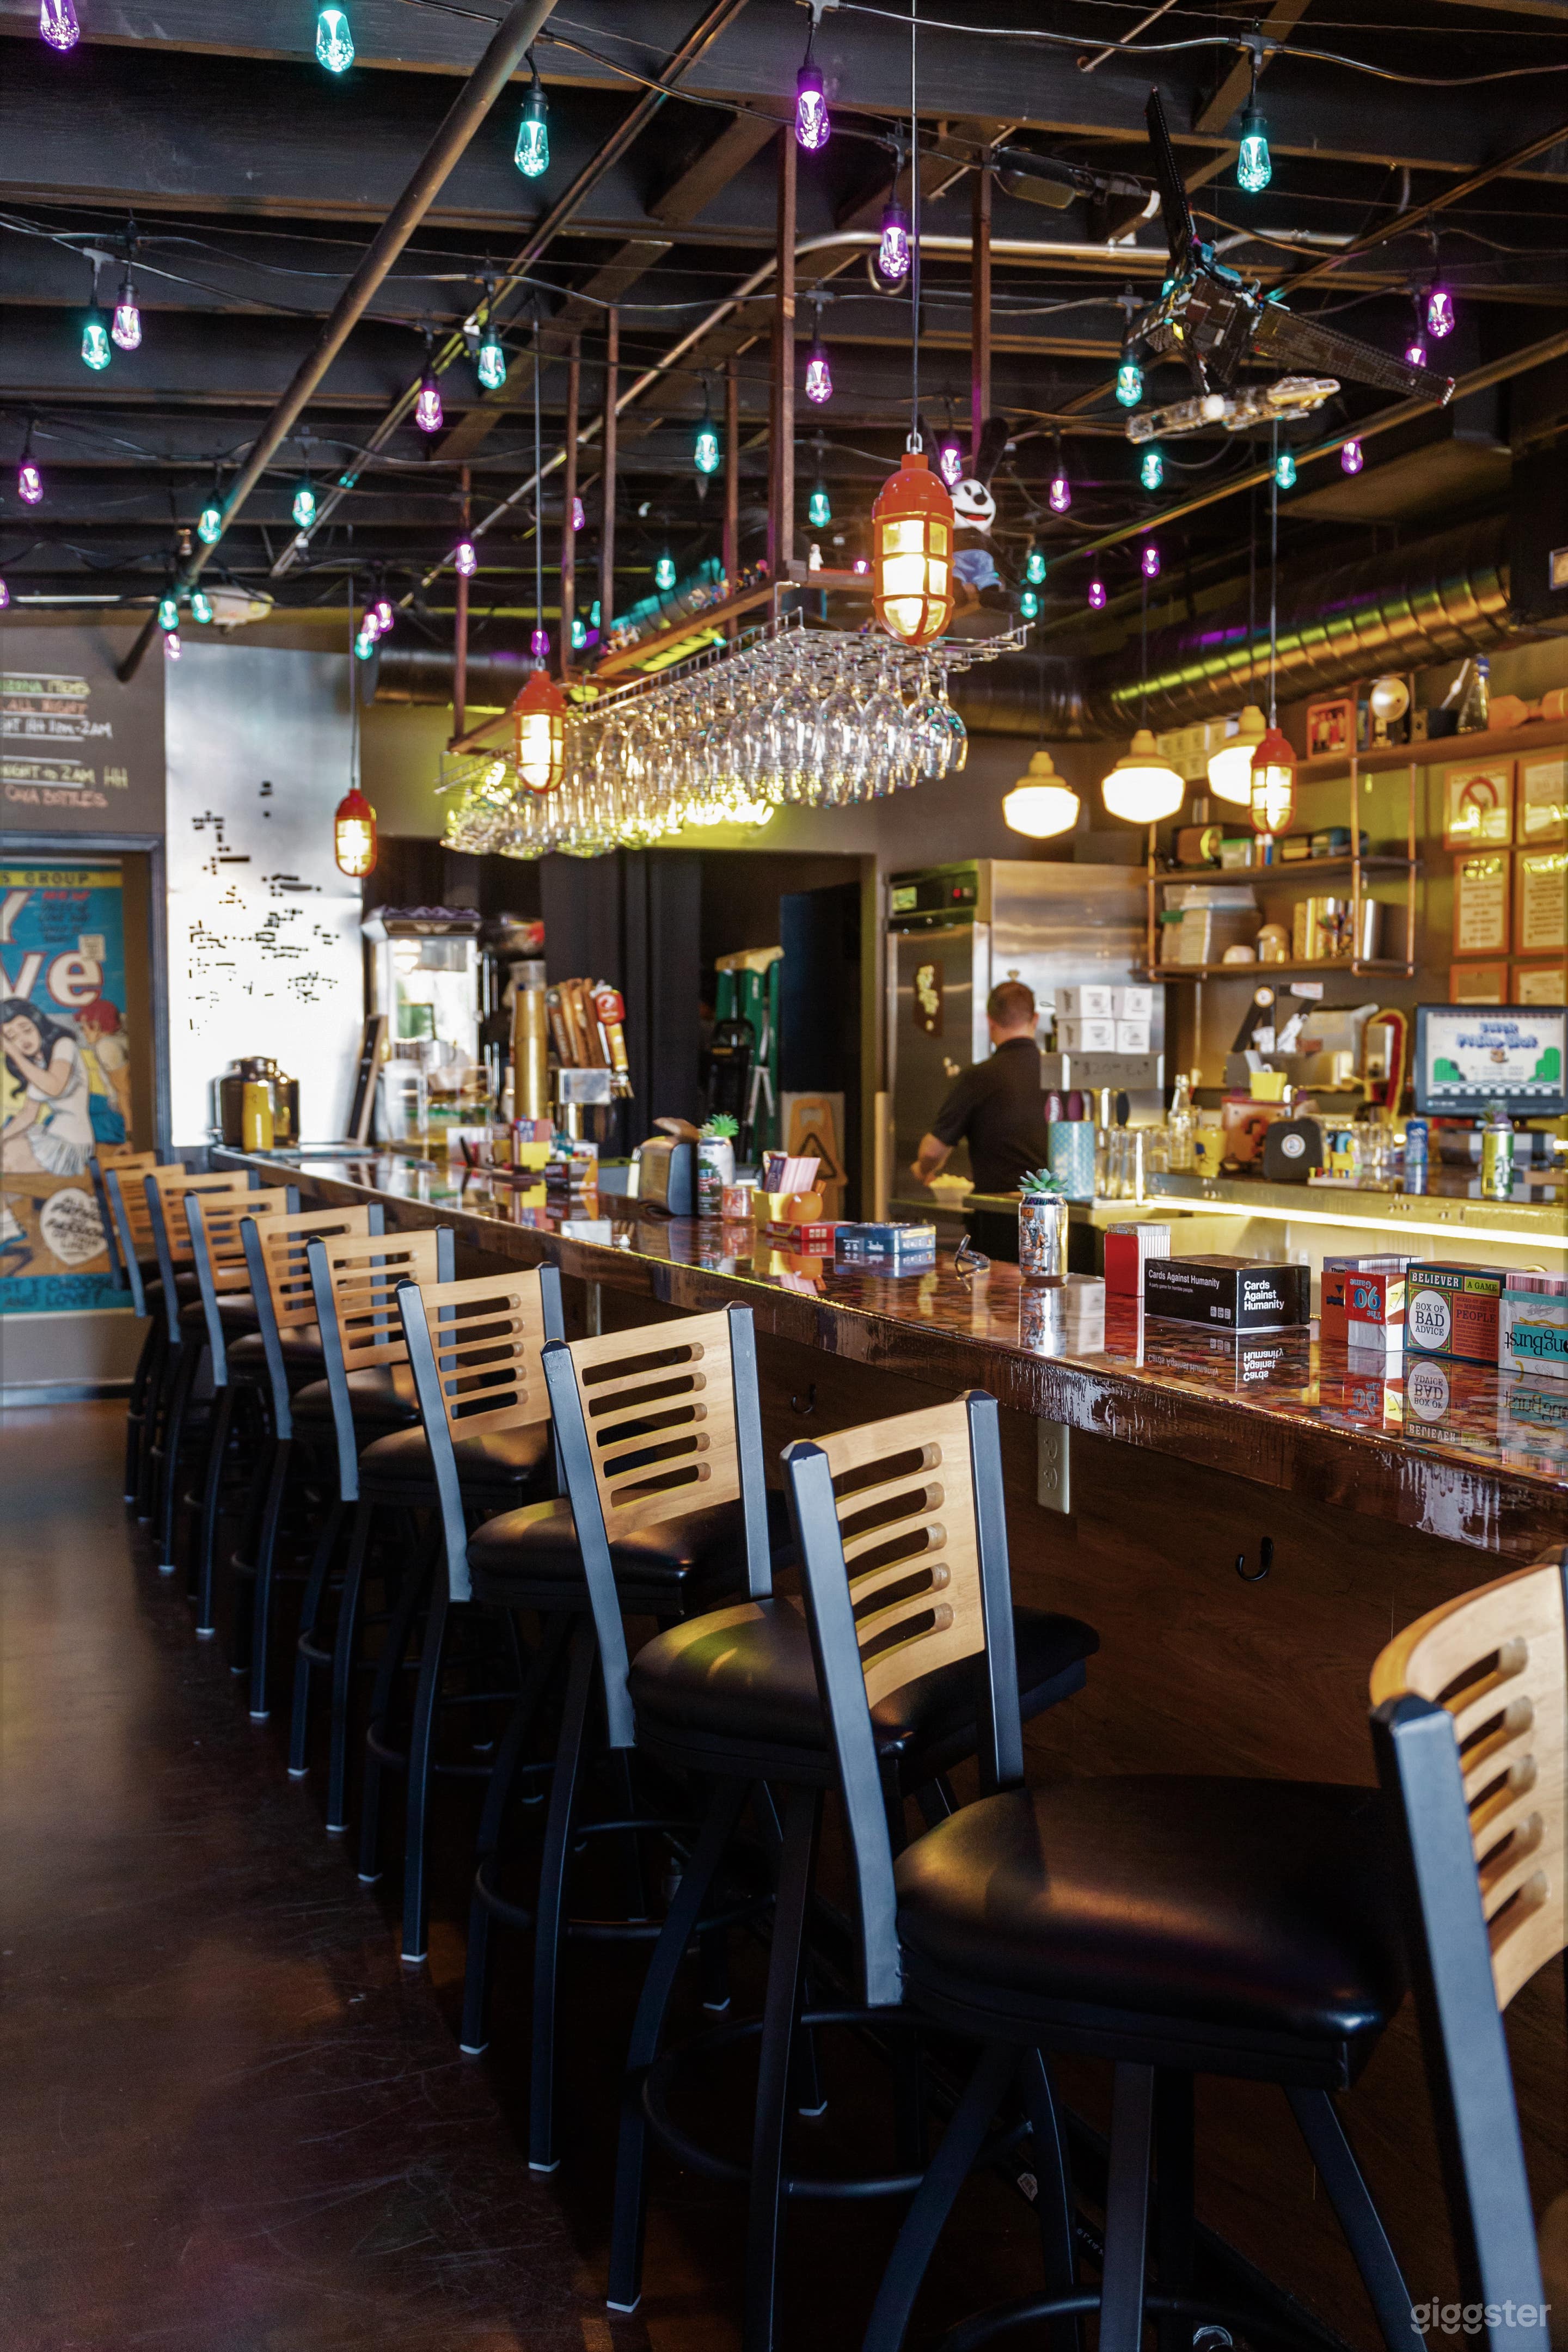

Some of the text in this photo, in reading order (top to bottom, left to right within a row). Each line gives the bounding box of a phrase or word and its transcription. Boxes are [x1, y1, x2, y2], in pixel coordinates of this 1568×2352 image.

[24, 872, 88, 885] GROUP
[1148, 1269, 1220, 1289] Cards Against Humanity
[1244, 1280, 1270, 1290] Cards
[1350, 1278, 1371, 1289] Game
[1412, 1272, 1459, 1288] BELIEVER
[1474, 1282, 1497, 1291] GAME
[1244, 1290, 1277, 1302] Against
[1244, 1300, 1284, 1310] Humanity
[1416, 1302, 1444, 1314] BOX OF
[1367, 1310, 1382, 1320] The
[1416, 1310, 1444, 1327] BAD
[1456, 1309, 1496, 1324] PEOPLE
[1416, 1325, 1444, 1336] ADVICE
